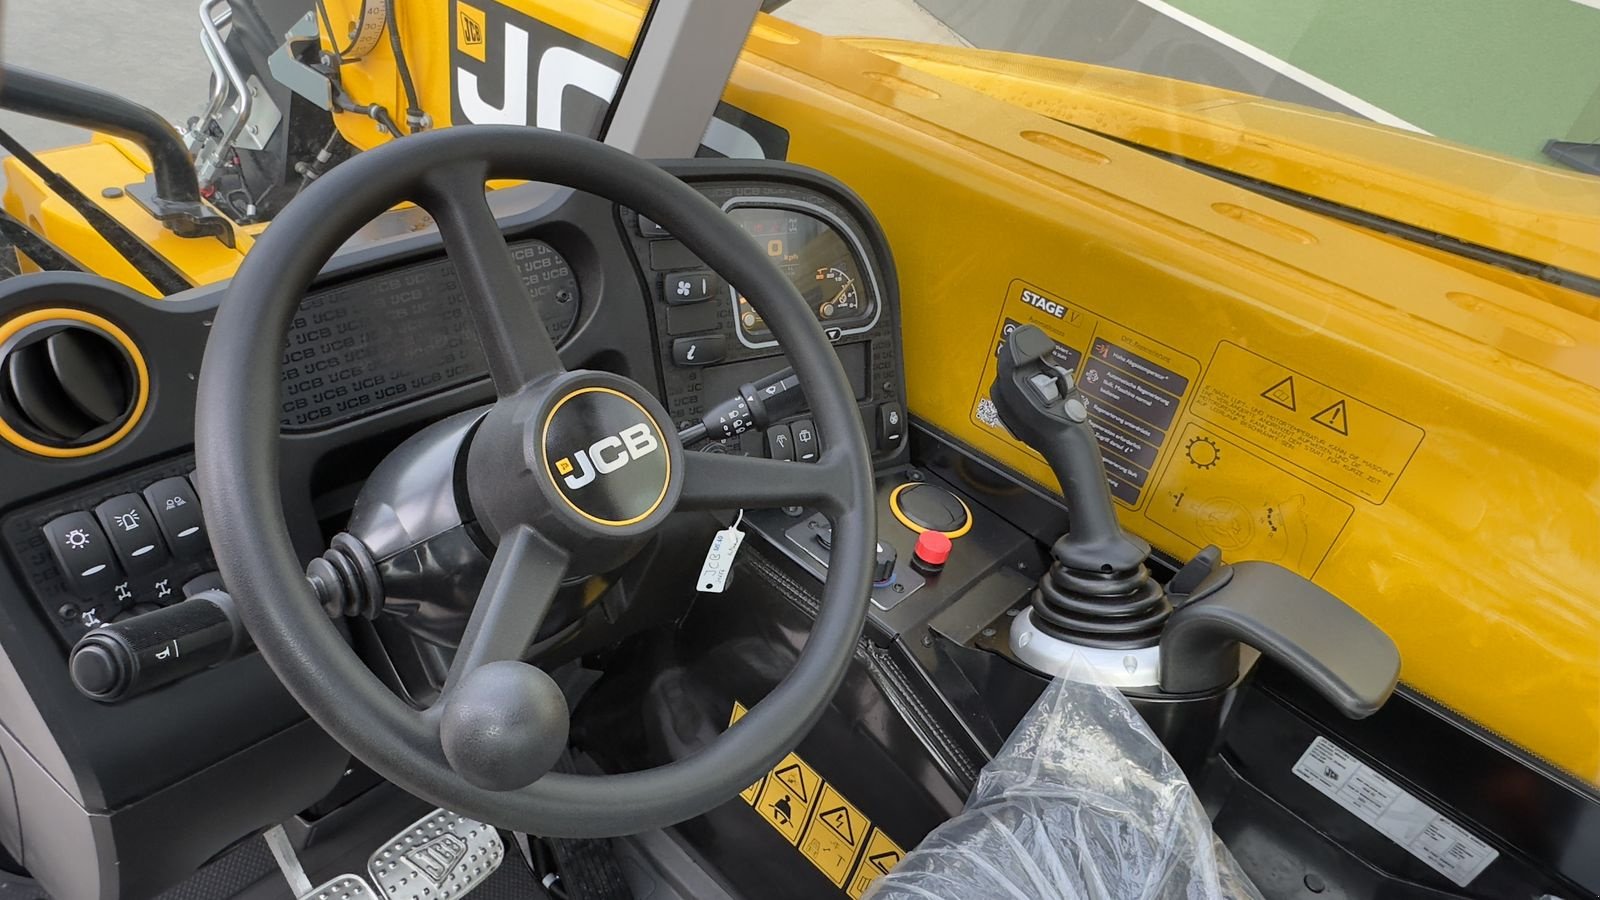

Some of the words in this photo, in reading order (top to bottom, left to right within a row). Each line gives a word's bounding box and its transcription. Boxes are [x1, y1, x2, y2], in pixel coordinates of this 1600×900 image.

[463, 16, 481, 42] JCB
[525, 258, 550, 270] JCB
[783, 253, 799, 262] kph
[543, 268, 567, 279] JCB
[1021, 290, 1064, 317] STAGE
[1068, 312, 1078, 323] V
[296, 327, 331, 343] JCB
[305, 357, 339, 373] JCB
[287, 378, 323, 394] JCB
[313, 386, 348, 402] JCB
[353, 375, 385, 390] JCB
[297, 406, 331, 423] JCB
[336, 395, 369, 411] JCB
[375, 383, 407, 399] JCB
[563, 423, 658, 490] JCB
[703, 553, 721, 577] JCB
[415, 838, 461, 880] JCB
